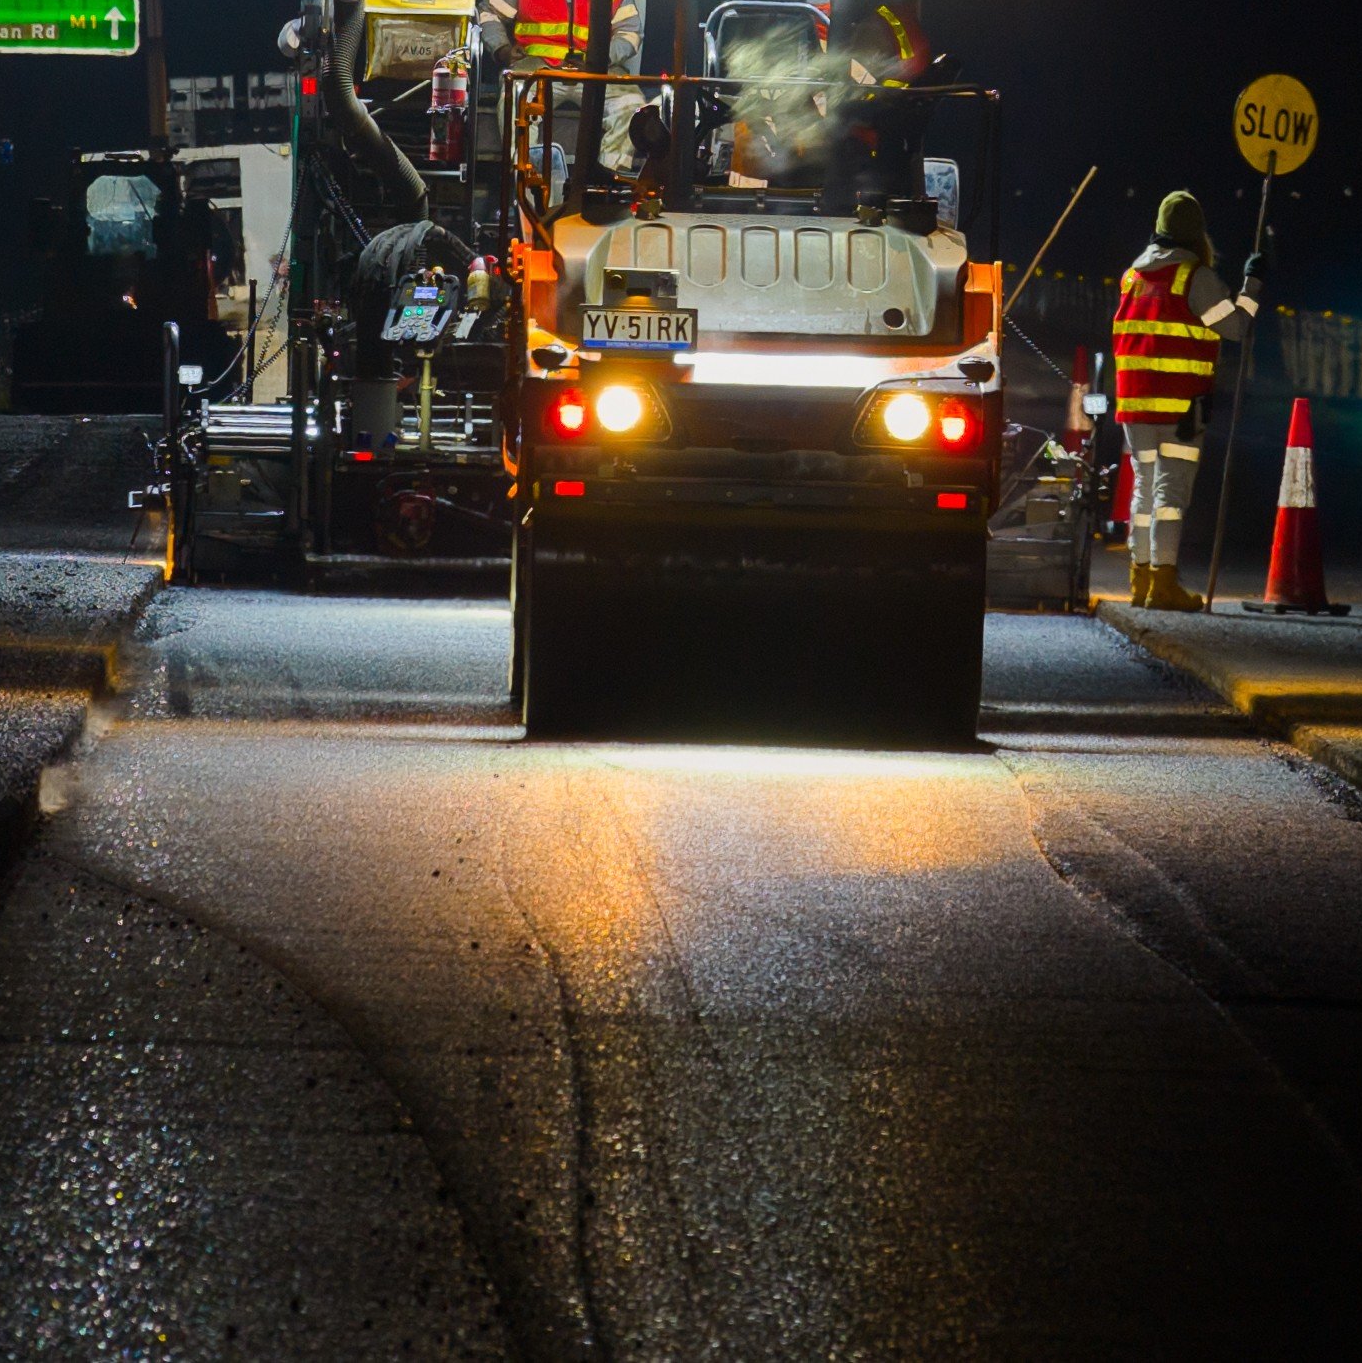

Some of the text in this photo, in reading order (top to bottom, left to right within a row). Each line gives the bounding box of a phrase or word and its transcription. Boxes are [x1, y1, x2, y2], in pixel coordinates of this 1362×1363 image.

[69, 14, 97, 29] M1
[31, 23, 56, 39] Rd
[1240, 102, 1313, 146] SLOW
